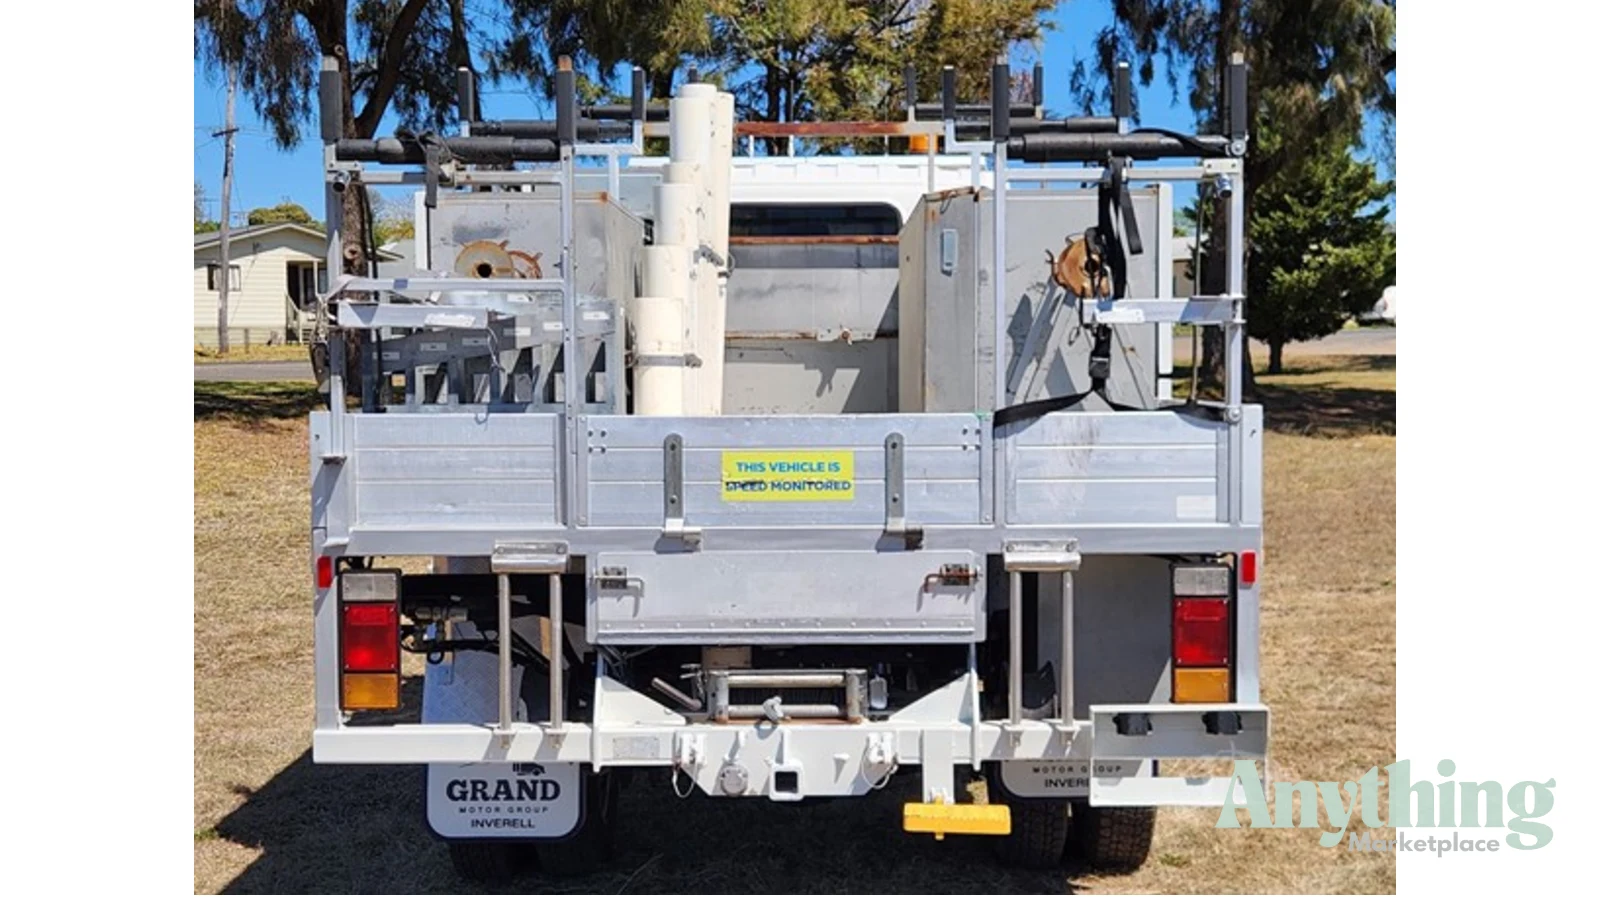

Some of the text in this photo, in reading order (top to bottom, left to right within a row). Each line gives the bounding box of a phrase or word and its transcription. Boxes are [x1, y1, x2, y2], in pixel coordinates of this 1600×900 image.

[736, 461, 841, 473] THIS VEHICLE IS
[726, 480, 851, 492] SPEED MONITORED
[1033, 765, 1074, 774] MOTOR
[446, 779, 561, 802] GRAND
[459, 806, 549, 814] MOTOR GROUP
[470, 818, 536, 829] INVERELL
